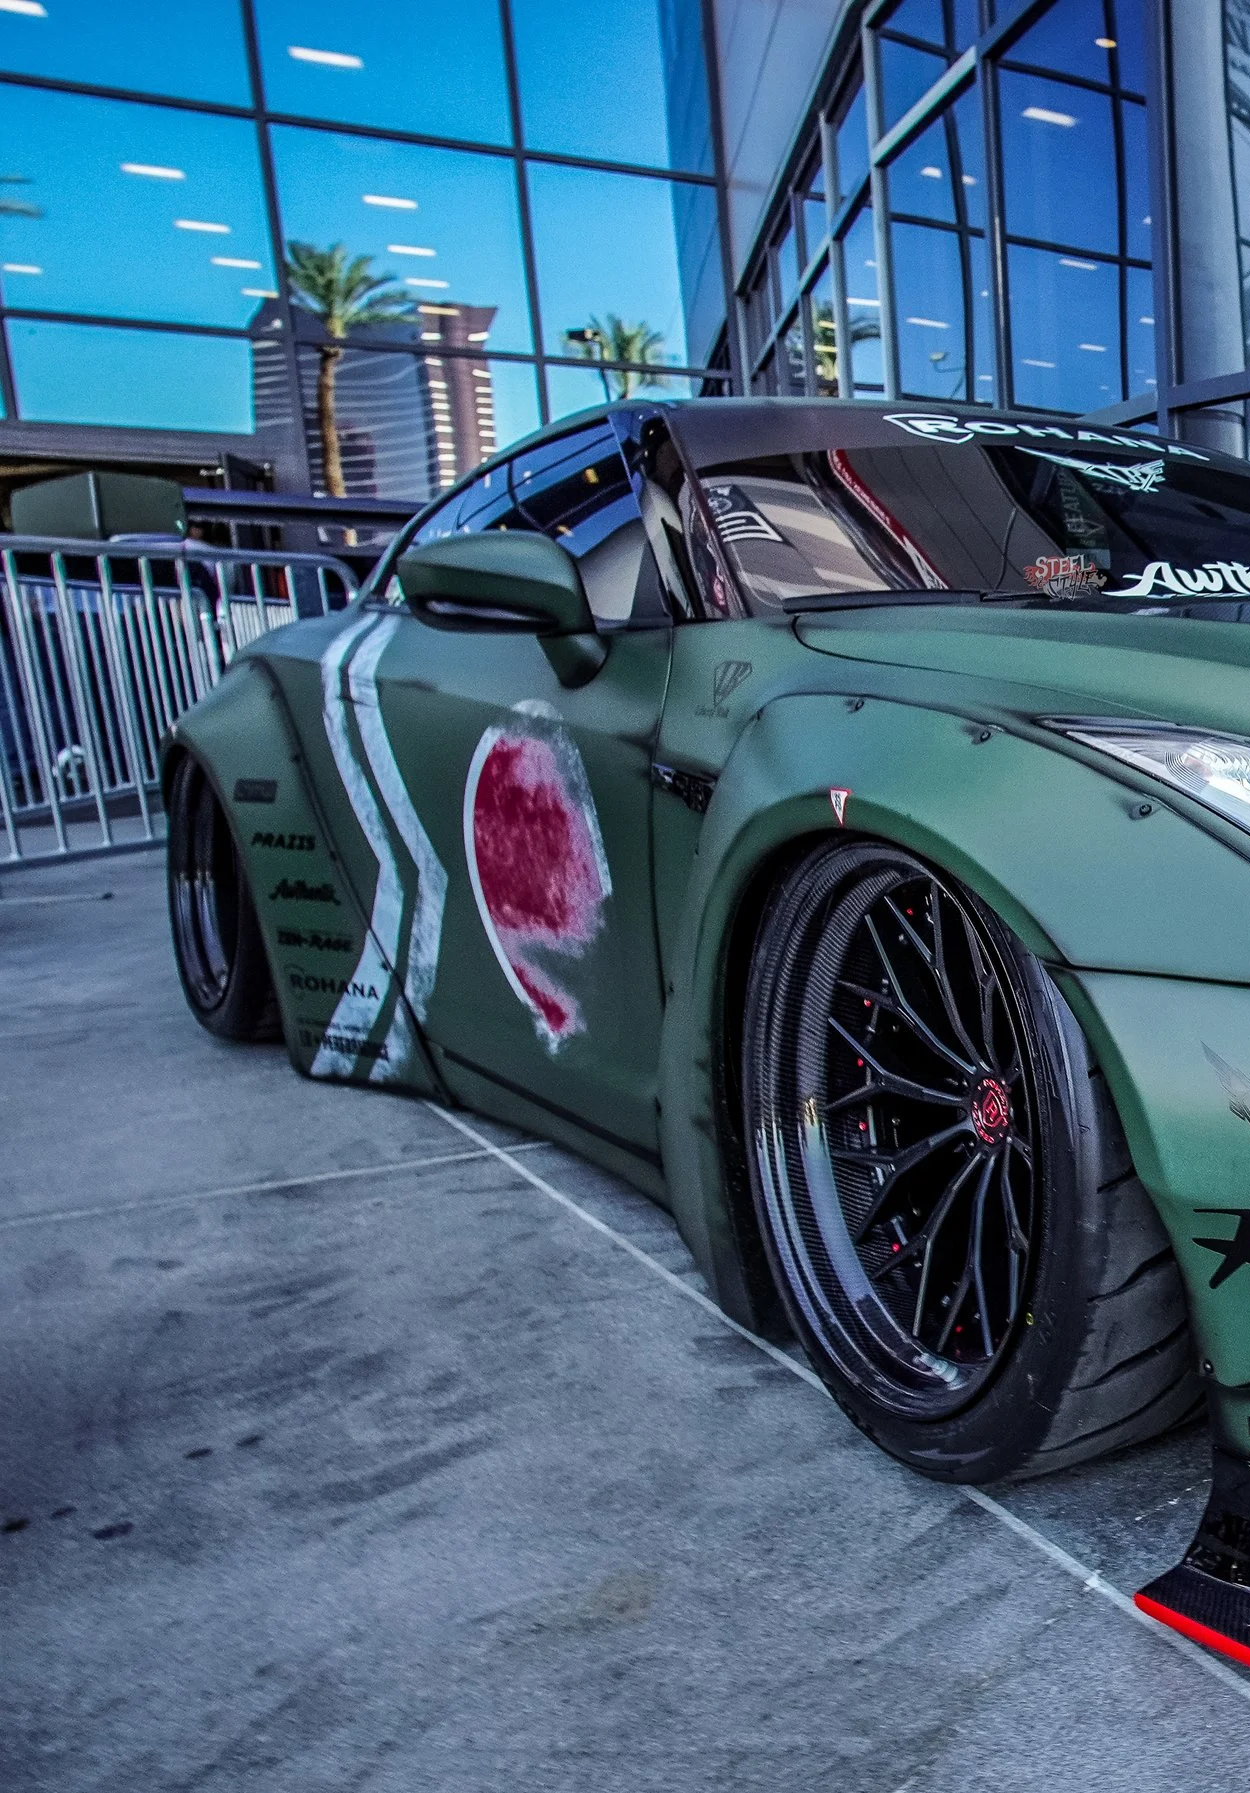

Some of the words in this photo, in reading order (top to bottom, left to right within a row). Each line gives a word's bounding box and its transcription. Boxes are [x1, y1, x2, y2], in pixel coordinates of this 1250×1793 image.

[885, 414, 1210, 461] ROHANA
[1035, 554, 1095, 578] STEEL
[290, 973, 380, 1001] ROHANA
